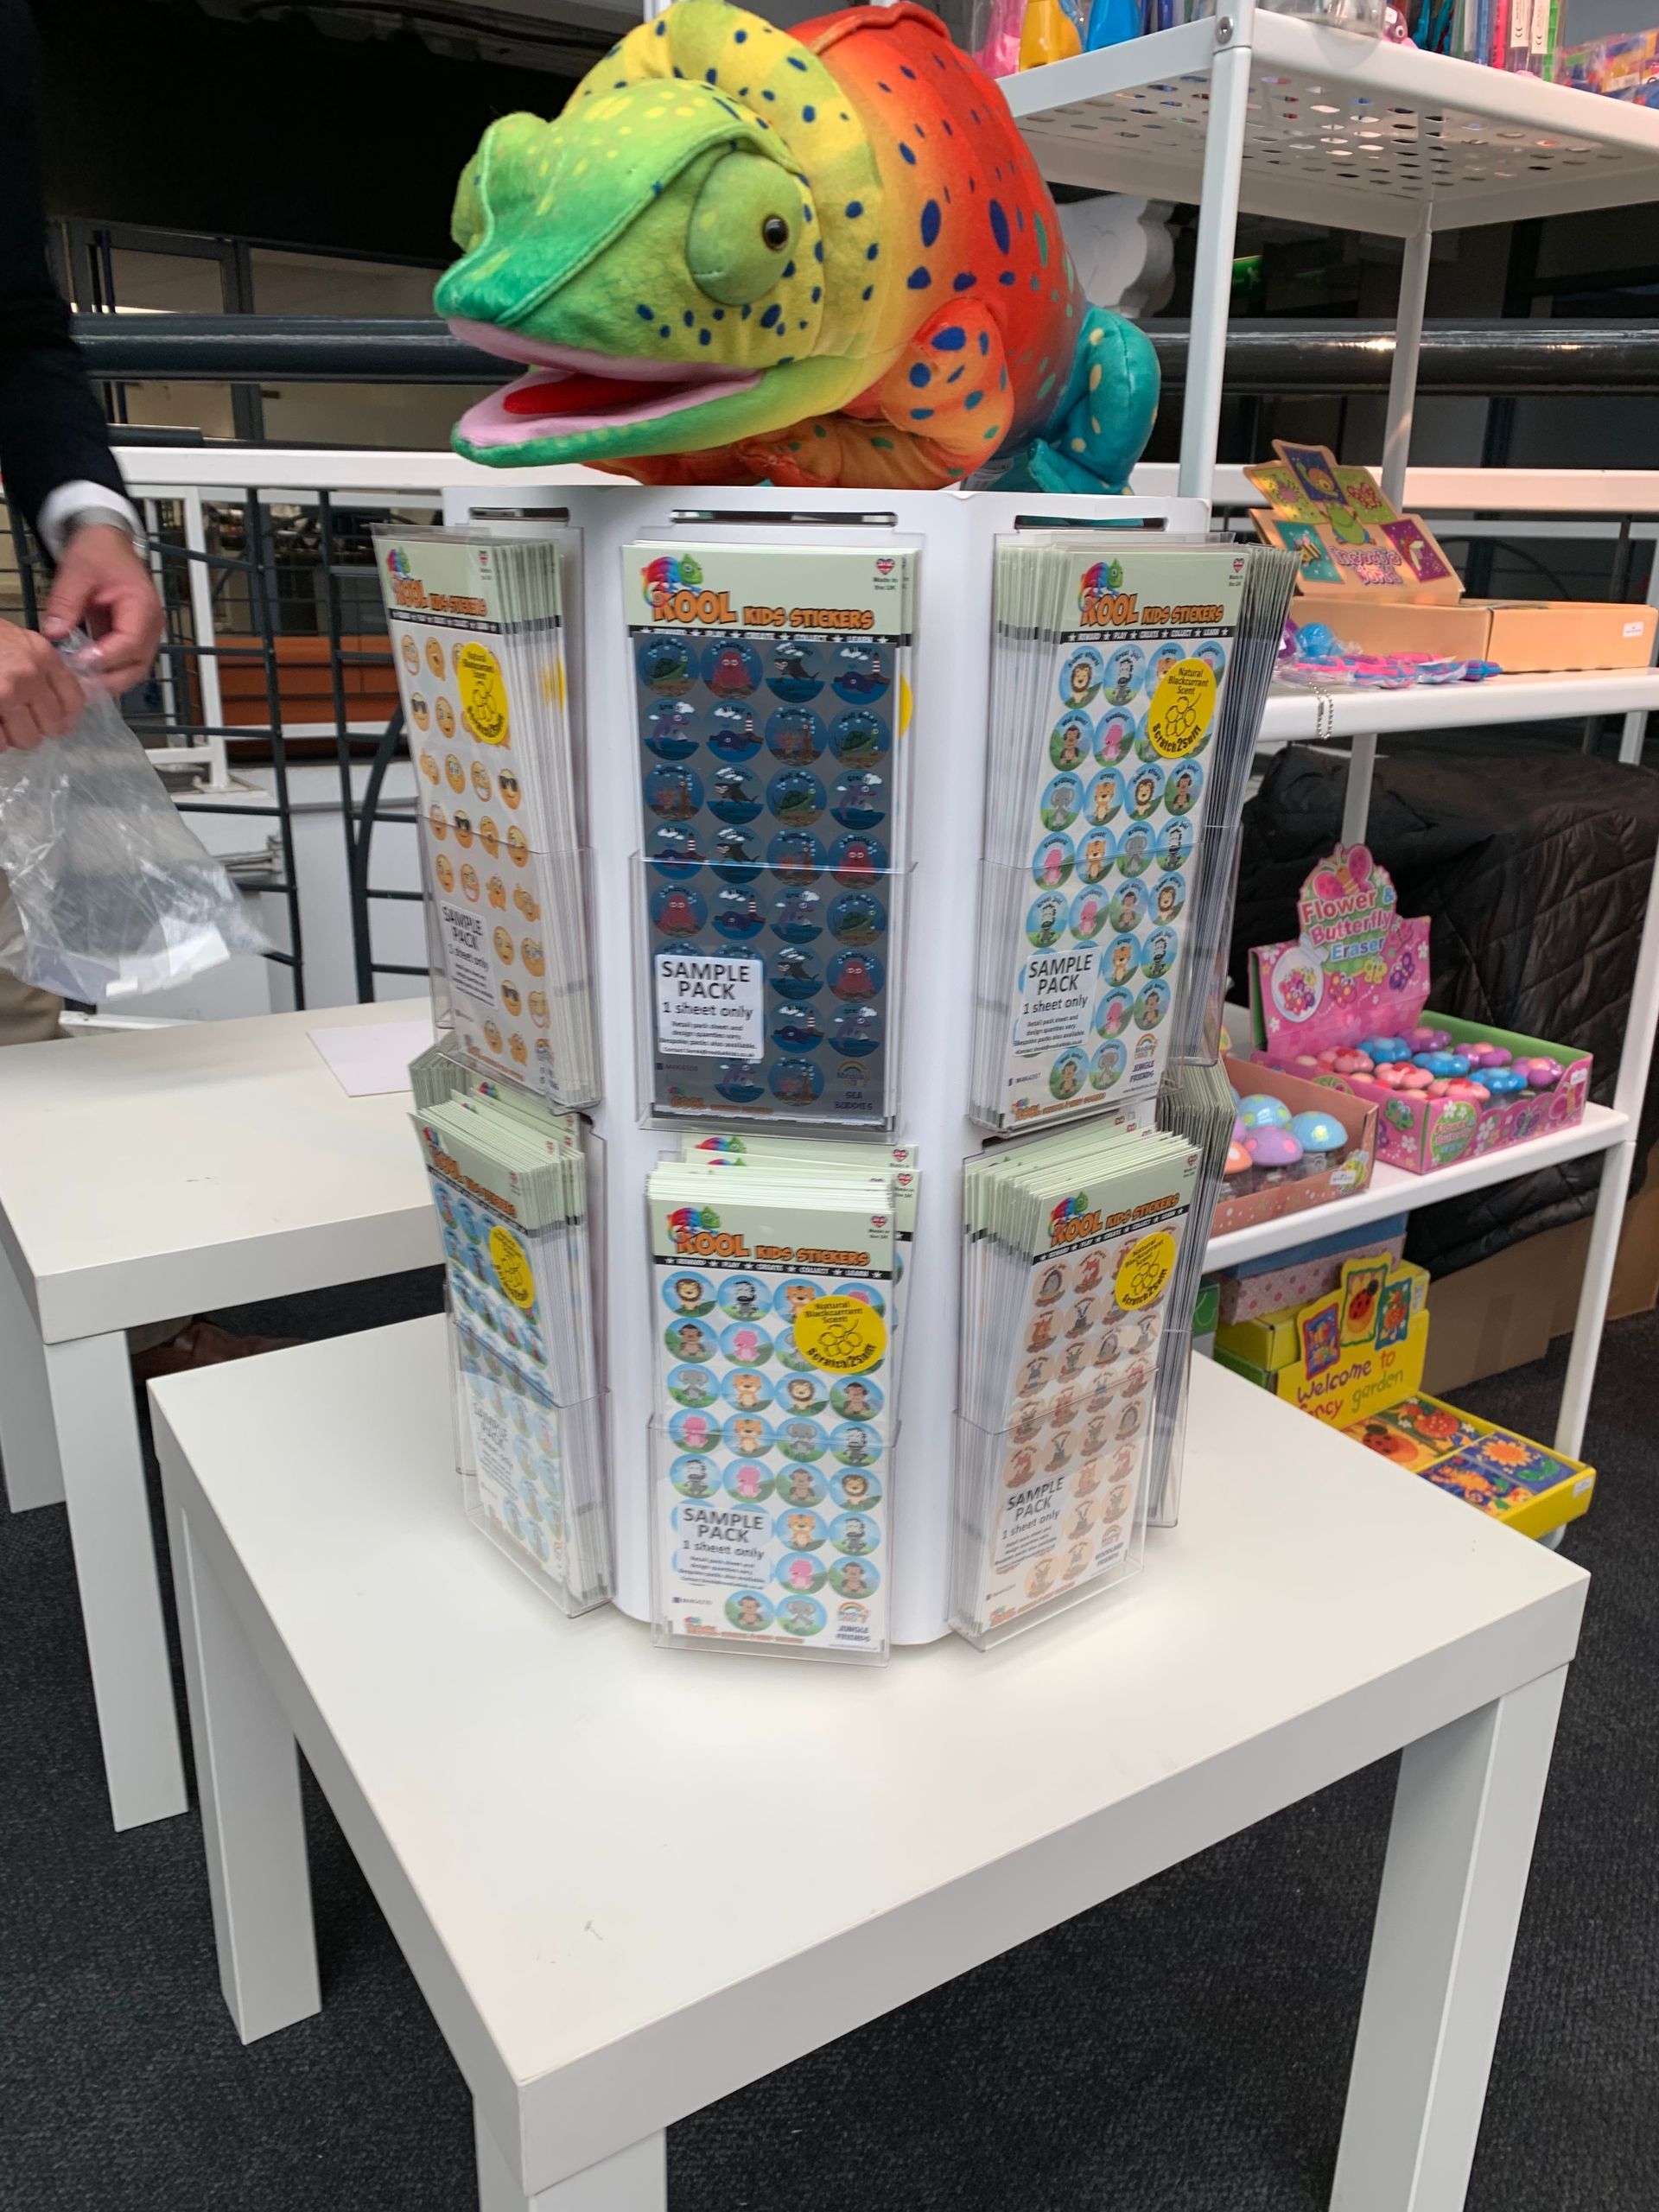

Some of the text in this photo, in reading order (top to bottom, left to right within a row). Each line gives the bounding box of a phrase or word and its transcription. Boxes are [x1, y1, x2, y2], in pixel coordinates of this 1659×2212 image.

[653, 589, 875, 631] KOOL KIDS STICKERS
[1081, 593, 1224, 627] KOOL KIDS STICKERS
[1168, 676, 1209, 687] Blackcurrant
[1179, 668, 1204, 677] Natural
[1177, 685, 1195, 695] Scent
[1301, 886, 1396, 925] Flower &
[442, 906, 484, 936] SAMPLE
[1310, 908, 1395, 948] Butterfly
[452, 925, 480, 950] PACK
[1331, 938, 1384, 962] Eraser
[661, 961, 751, 982] SAMPLE
[1028, 954, 1093, 979] SAMPLE
[678, 981, 736, 1000] PACK
[1037, 974, 1080, 995] PACK
[663, 1001, 753, 1020] 1 sheet only
[1023, 994, 1089, 1014] 1 sheet only
[1129, 1070, 1154, 1083] FRIENDS
[1133, 1059, 1155, 1072] JUNGLE
[1051, 1192, 1180, 1248] KOOL KIDS STICKERS
[676, 1231, 871, 1267] KOOL KIDS STICKERS
[1133, 1237, 1157, 1255] Natural
[1297, 1350, 1396, 1402] Welcome to
[1351, 1370, 1403, 1414] garden
[1007, 1476, 1065, 1511] SAMPLE
[683, 1508, 764, 1529] SAMPLE
[1015, 1495, 1052, 1521] PACK
[697, 1524, 750, 1543] PACK
[1002, 1510, 1061, 1540] 1 sheet only
[683, 1540, 765, 1560] 1 sheet only
